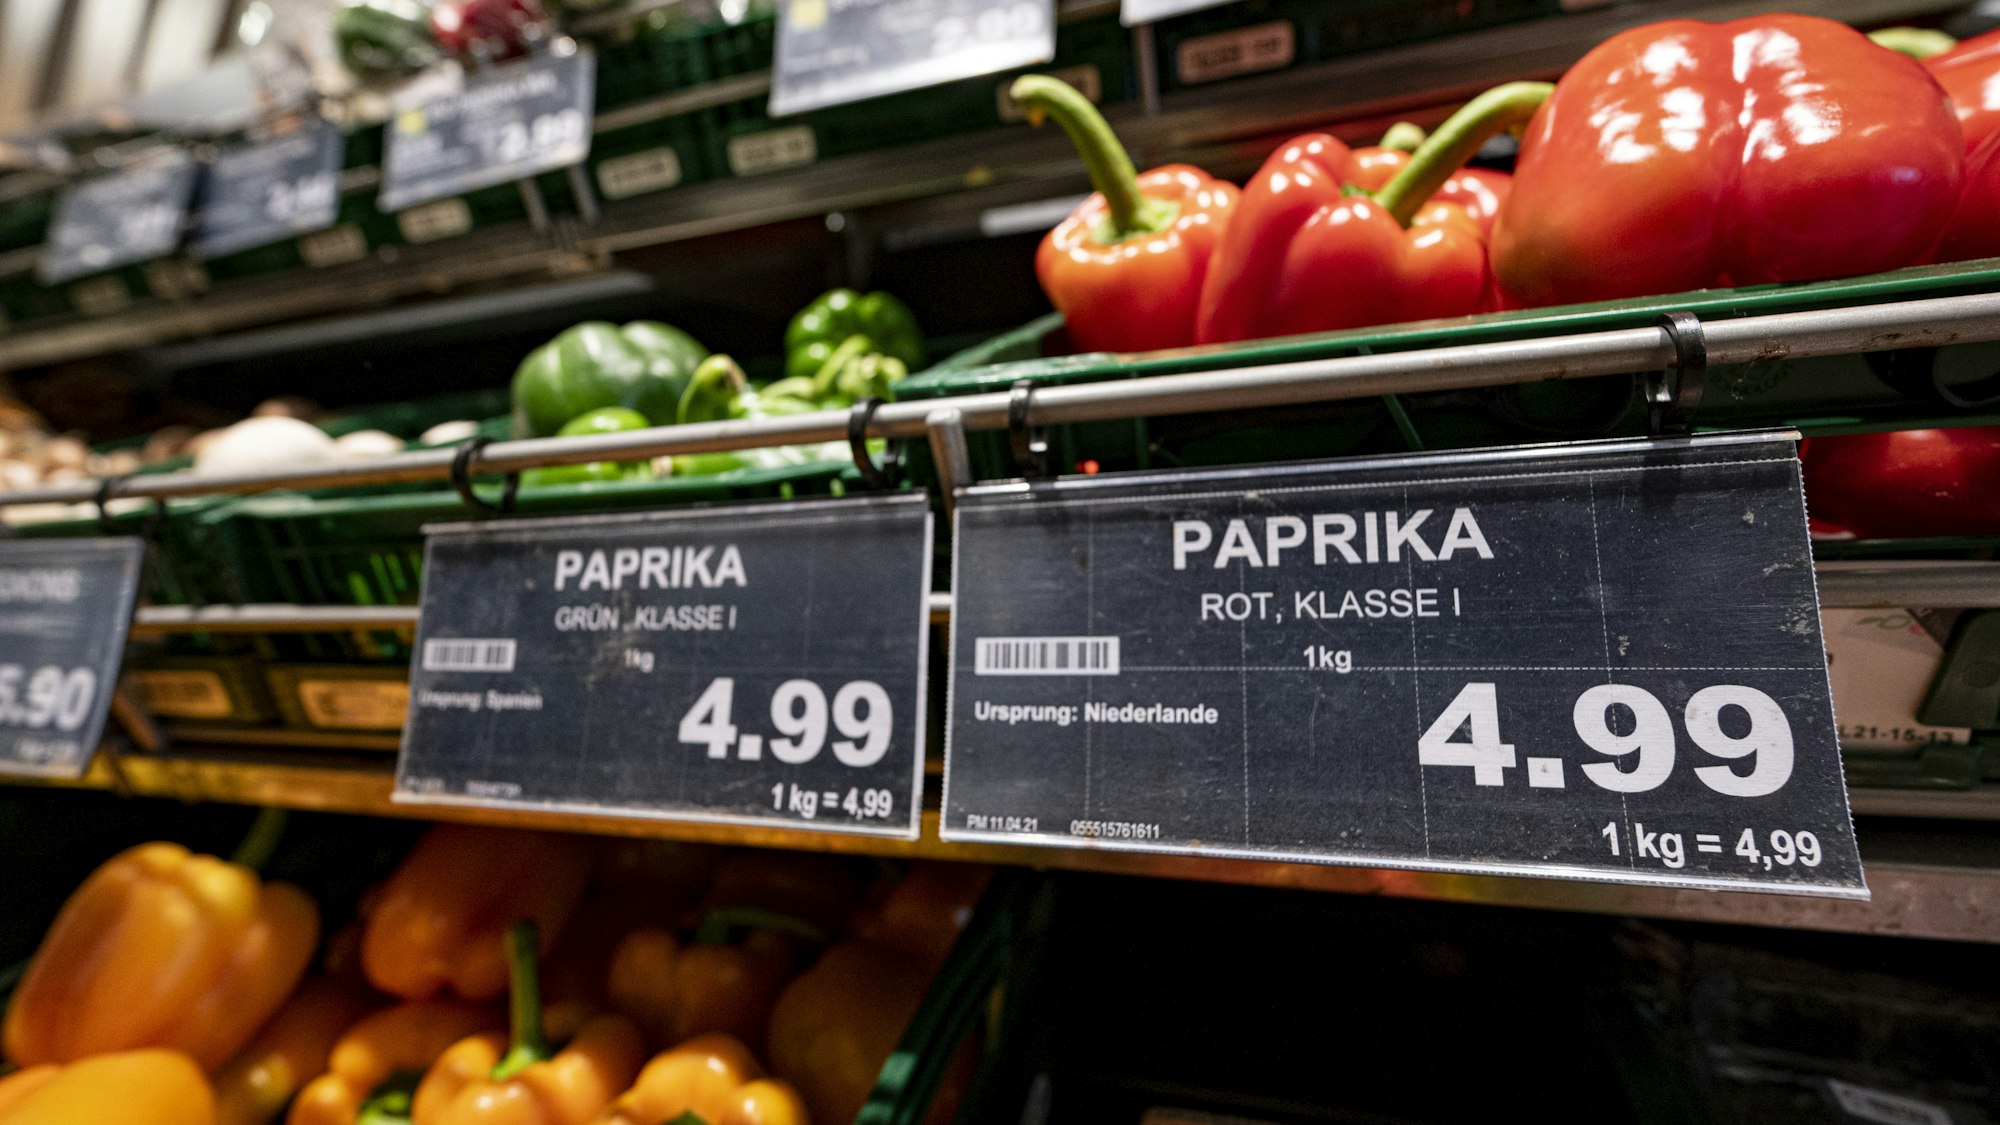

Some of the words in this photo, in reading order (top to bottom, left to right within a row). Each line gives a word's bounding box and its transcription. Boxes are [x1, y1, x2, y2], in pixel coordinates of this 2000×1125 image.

[1173, 507, 1494, 570] PAPRIKA
[554, 544, 748, 591] PAPRIKA
[634, 605, 725, 631] KLASSE
[729, 605, 737, 631] I
[1201, 592, 1282, 624] ROT,
[1295, 588, 1440, 620] KLASSE
[1453, 587, 1461, 617] I
[1303, 645, 1353, 674] 1kg
[678, 677, 893, 767] 4.99
[974, 701, 1078, 726] Ursprung:
[1084, 702, 1219, 724] Niederlande
[1418, 682, 1794, 797] 4.99
[771, 782, 784, 810] 1
[789, 783, 818, 819] kg
[842, 787, 893, 820] 4,99
[967, 814, 988, 829] PM
[990, 816, 1038, 832] 11.04.21
[1602, 822, 1620, 857] 1
[1635, 823, 1685, 868] kg
[1735, 827, 1822, 871] 4,99
